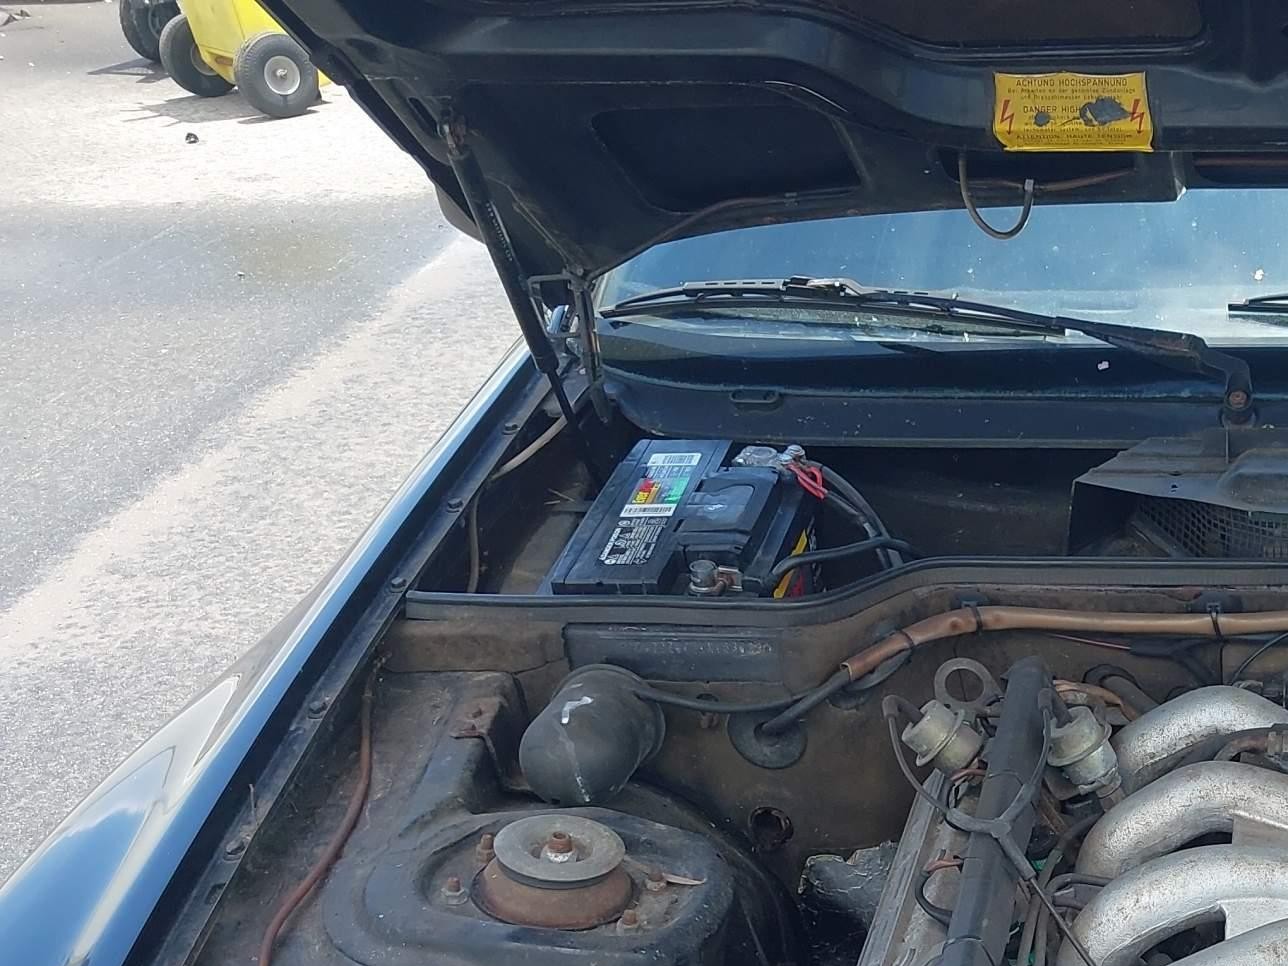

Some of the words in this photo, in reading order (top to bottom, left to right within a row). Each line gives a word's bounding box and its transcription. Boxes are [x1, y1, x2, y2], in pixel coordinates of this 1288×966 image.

[1016, 79, 1055, 87] ACHTUNG
[1058, 79, 1128, 87] HOCHSPANNUNG
[1023, 105, 1057, 113] DANGER
[1061, 105, 1081, 113] HIGH
